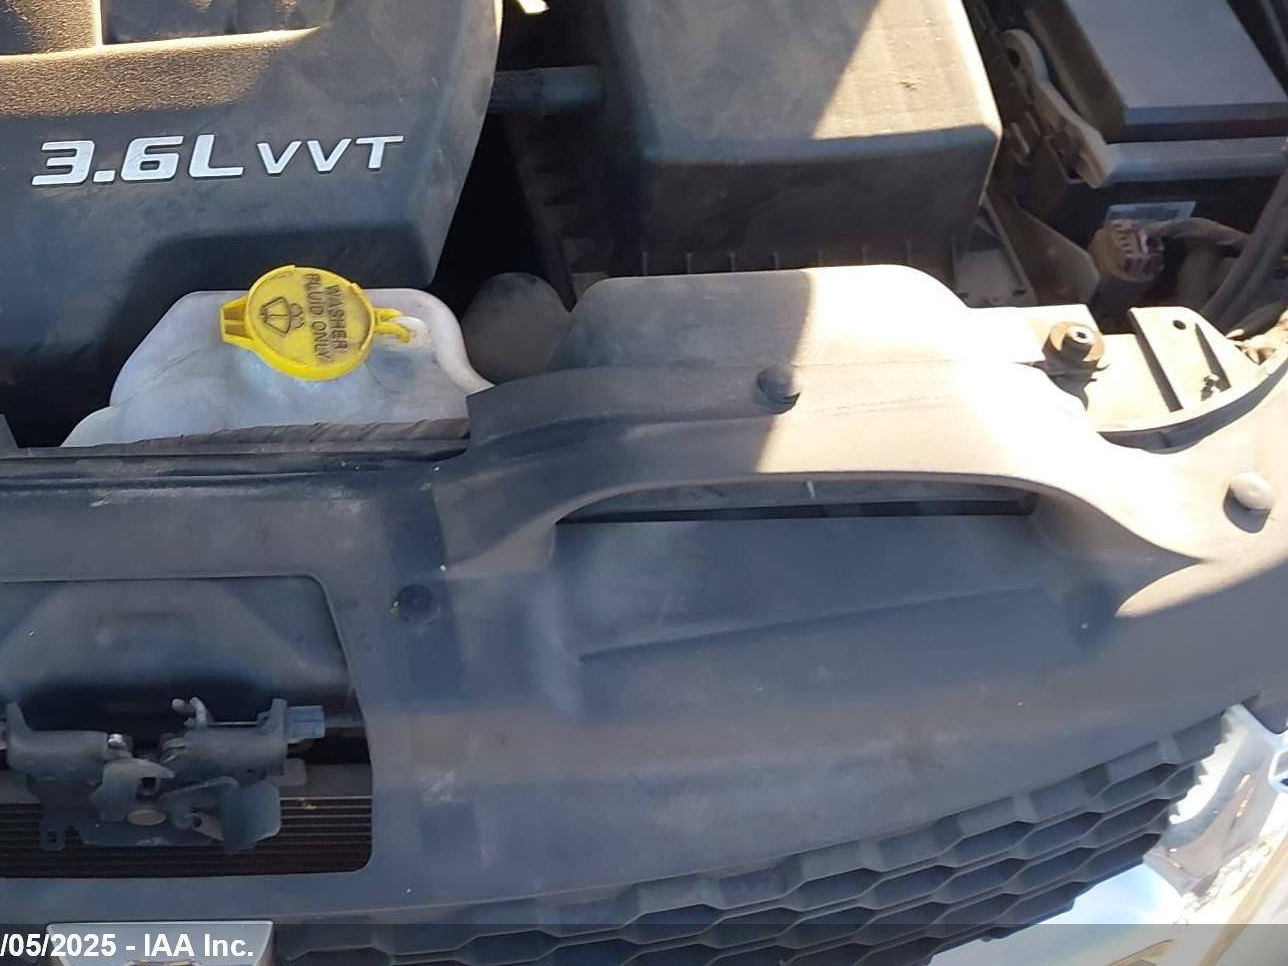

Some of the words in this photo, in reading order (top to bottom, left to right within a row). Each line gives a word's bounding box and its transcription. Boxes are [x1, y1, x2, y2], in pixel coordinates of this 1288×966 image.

[31, 133, 245, 187] 3.6L
[256, 135, 405, 175] VVT
[303, 272, 325, 317] FLUID
[324, 283, 349, 351] WASHER
[311, 319, 334, 364] ONLY
